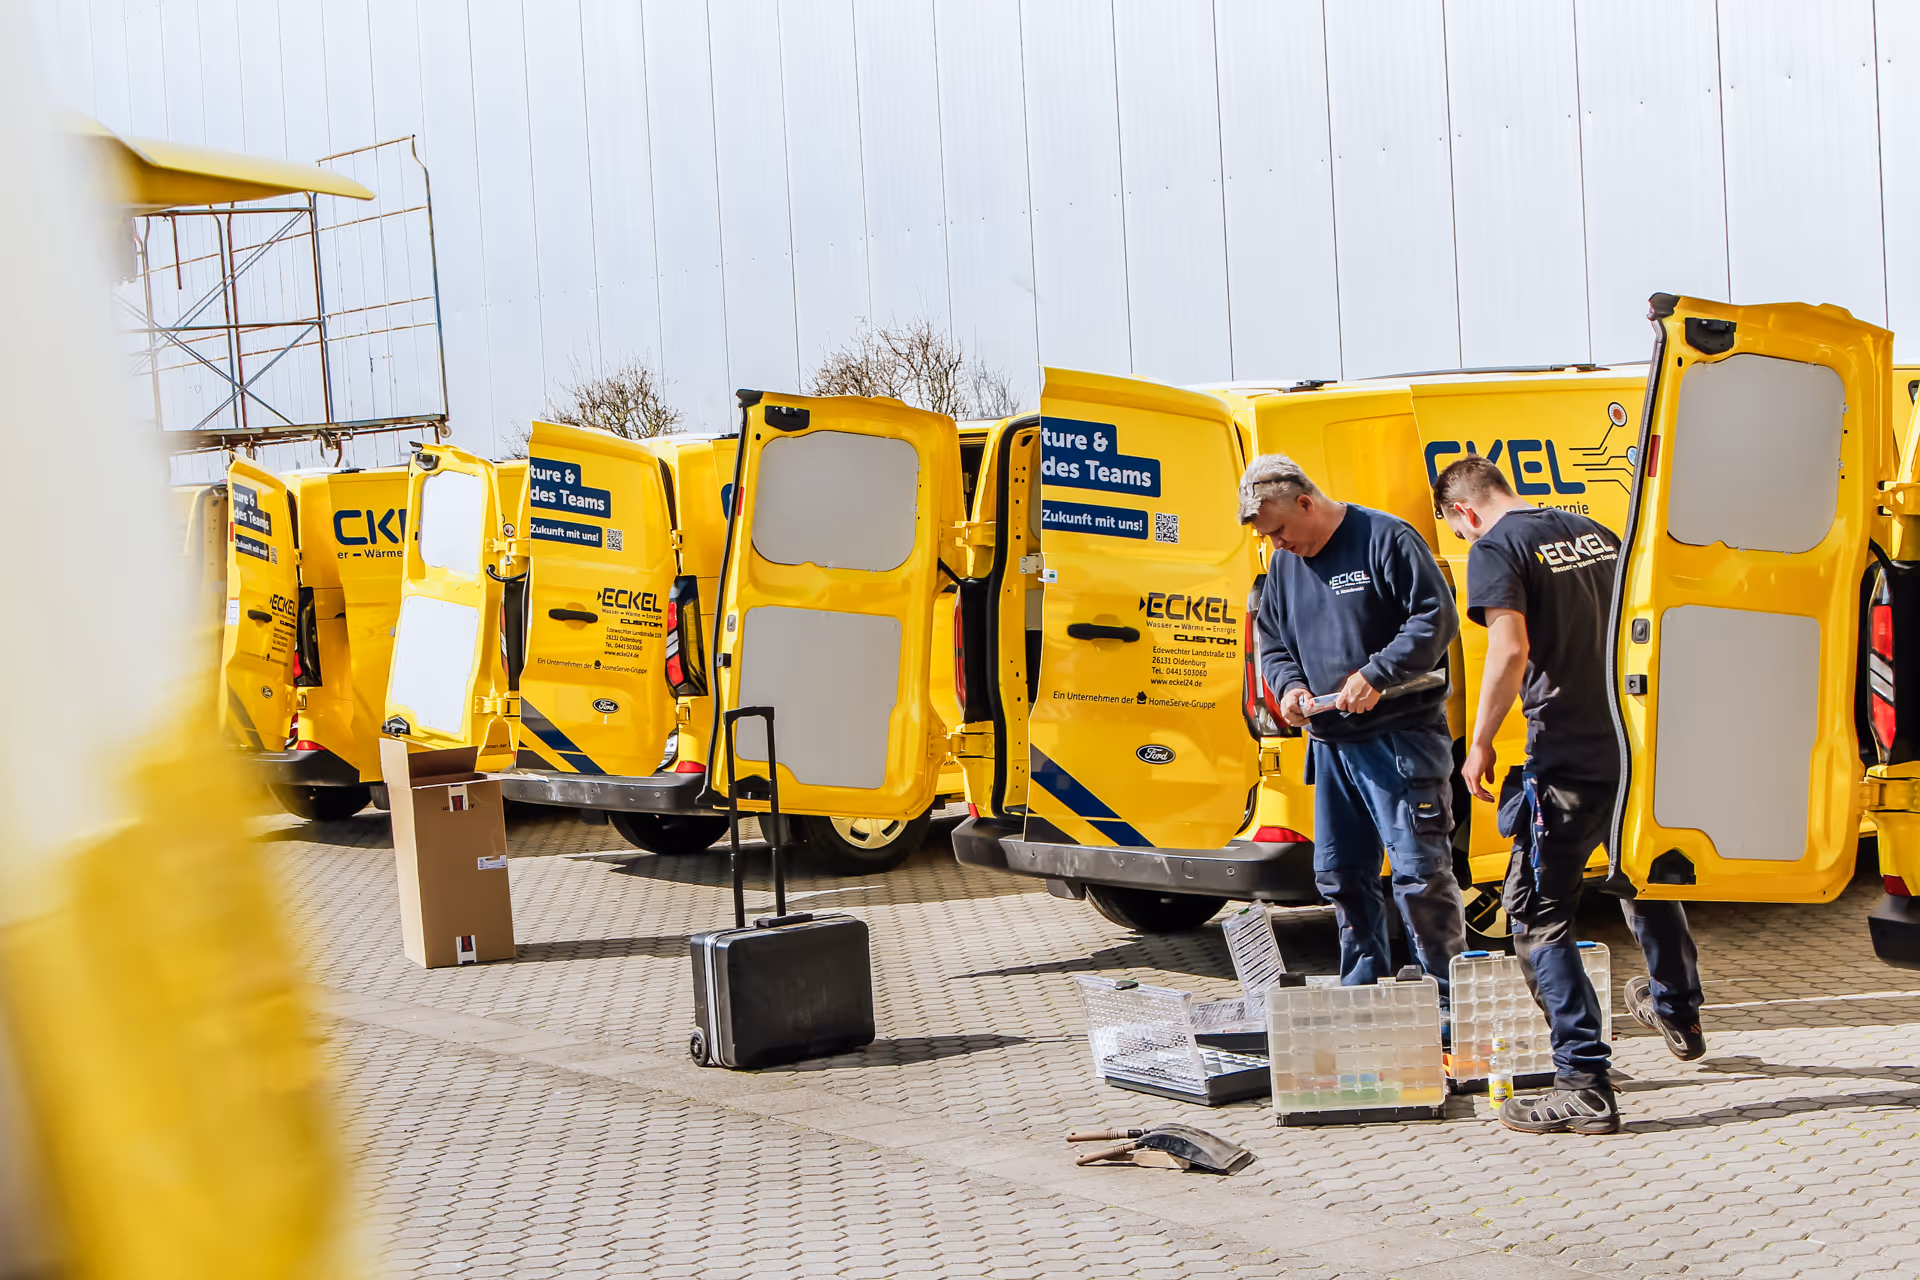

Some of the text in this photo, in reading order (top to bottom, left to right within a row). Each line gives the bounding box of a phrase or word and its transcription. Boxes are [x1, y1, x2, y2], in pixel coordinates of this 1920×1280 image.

[1042, 428, 1108, 452] ture &
[530, 464, 576, 484] ture &
[1042, 456, 1152, 487] des Teams
[530, 486, 605, 511] des Teams
[1042, 509, 1143, 531] Zukunft mit uns!
[530, 524, 599, 542] Zukunft mit uns!
[364, 549, 403, 558] Wärme
[1539, 533, 1614, 565] ECKEL
[1332, 570, 1370, 586] ECKEL
[602, 588, 662, 613] ECKEL
[1146, 592, 1236, 624] ECKEL
[1146, 620, 1172, 628] Wasser
[1213, 626, 1236, 634] Energie
[1174, 634, 1237, 645] CUSTOM
[1153, 646, 1190, 655] Edewechter
[1192, 649, 1224, 658] Landstraße
[547, 659, 582, 669] Unternehmen
[1173, 658, 1206, 668] Oldenburg
[1151, 678, 1202, 687] www.eckel24.de
[1053, 691, 1216, 710] Ein Unternehmen der HomeServe-Gruppe
